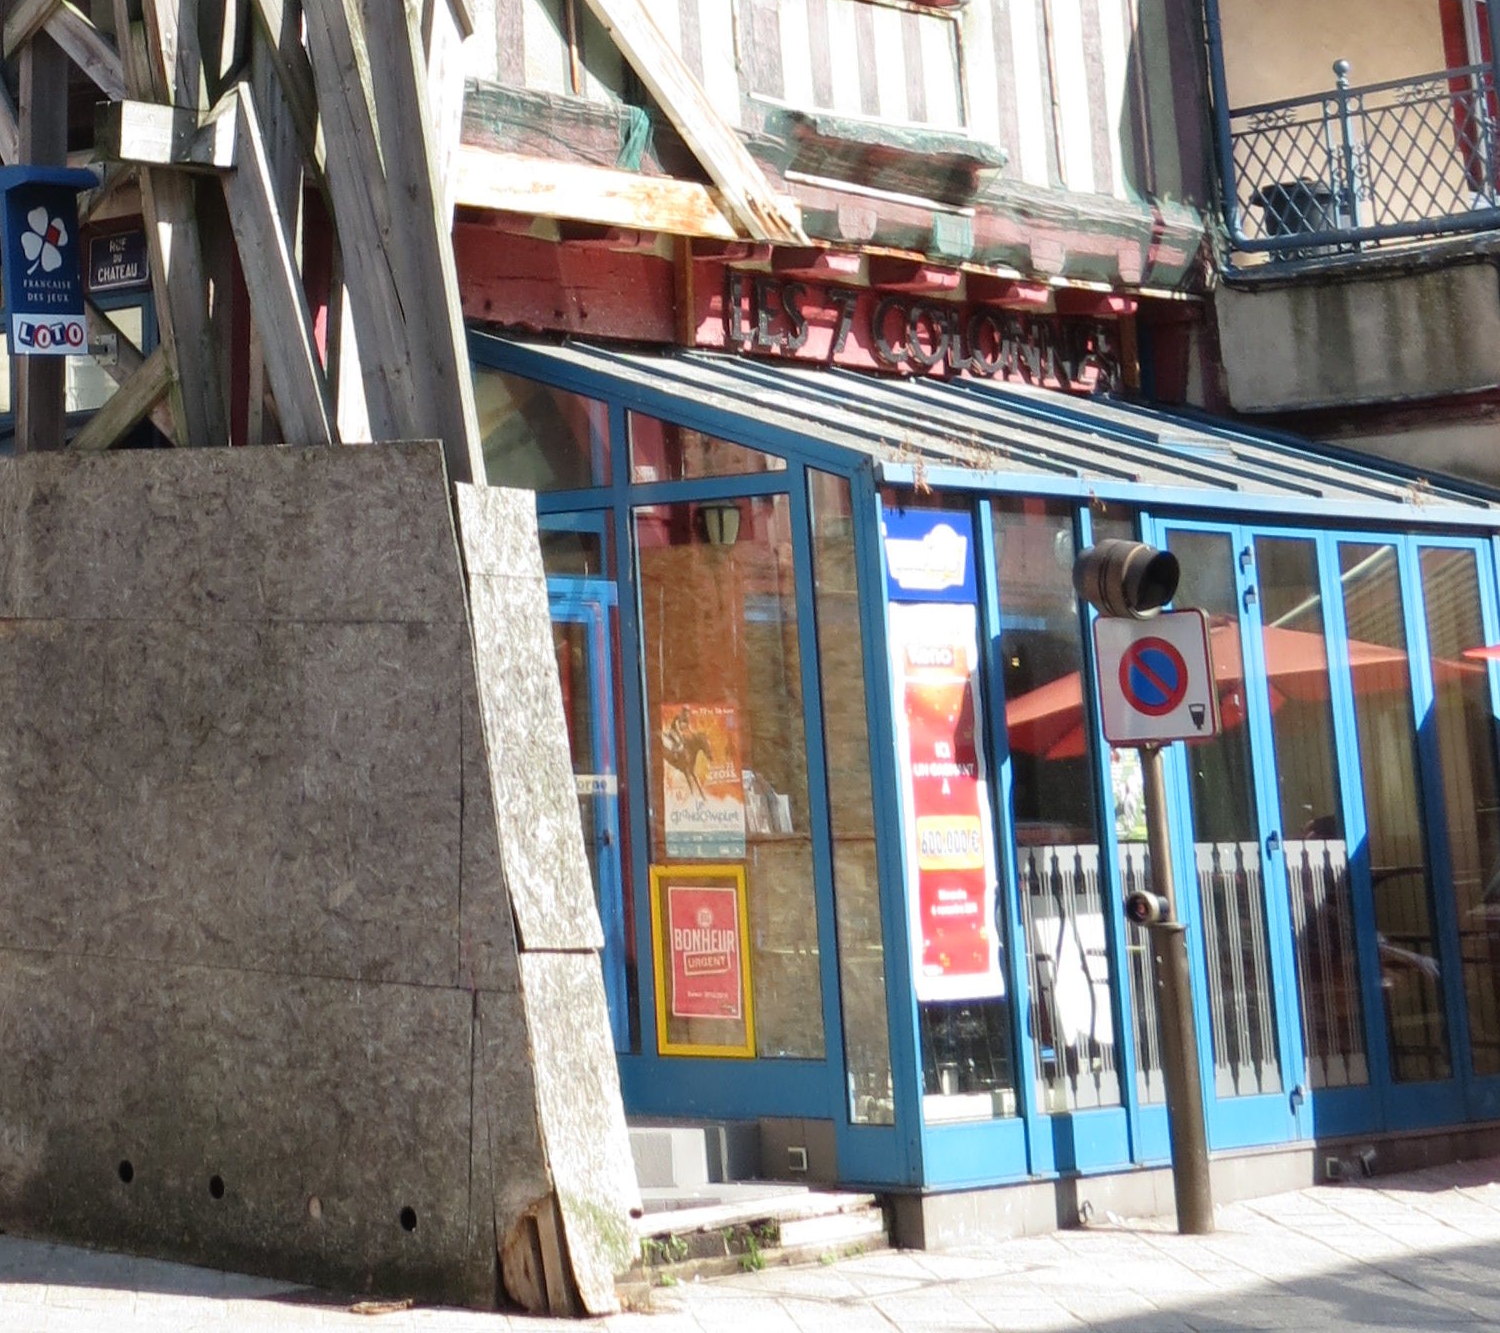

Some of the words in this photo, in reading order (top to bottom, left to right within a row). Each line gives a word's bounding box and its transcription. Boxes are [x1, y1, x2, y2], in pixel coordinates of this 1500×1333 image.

[97, 263, 138, 283] CHATEAU
[47, 293, 70, 304] JEUX
[727, 270, 809, 350] LES
[827, 288, 858, 353] 7
[19, 321, 84, 349] LOTO
[674, 928, 736, 953] BONHEUR
[687, 955, 727, 969] URGENT
